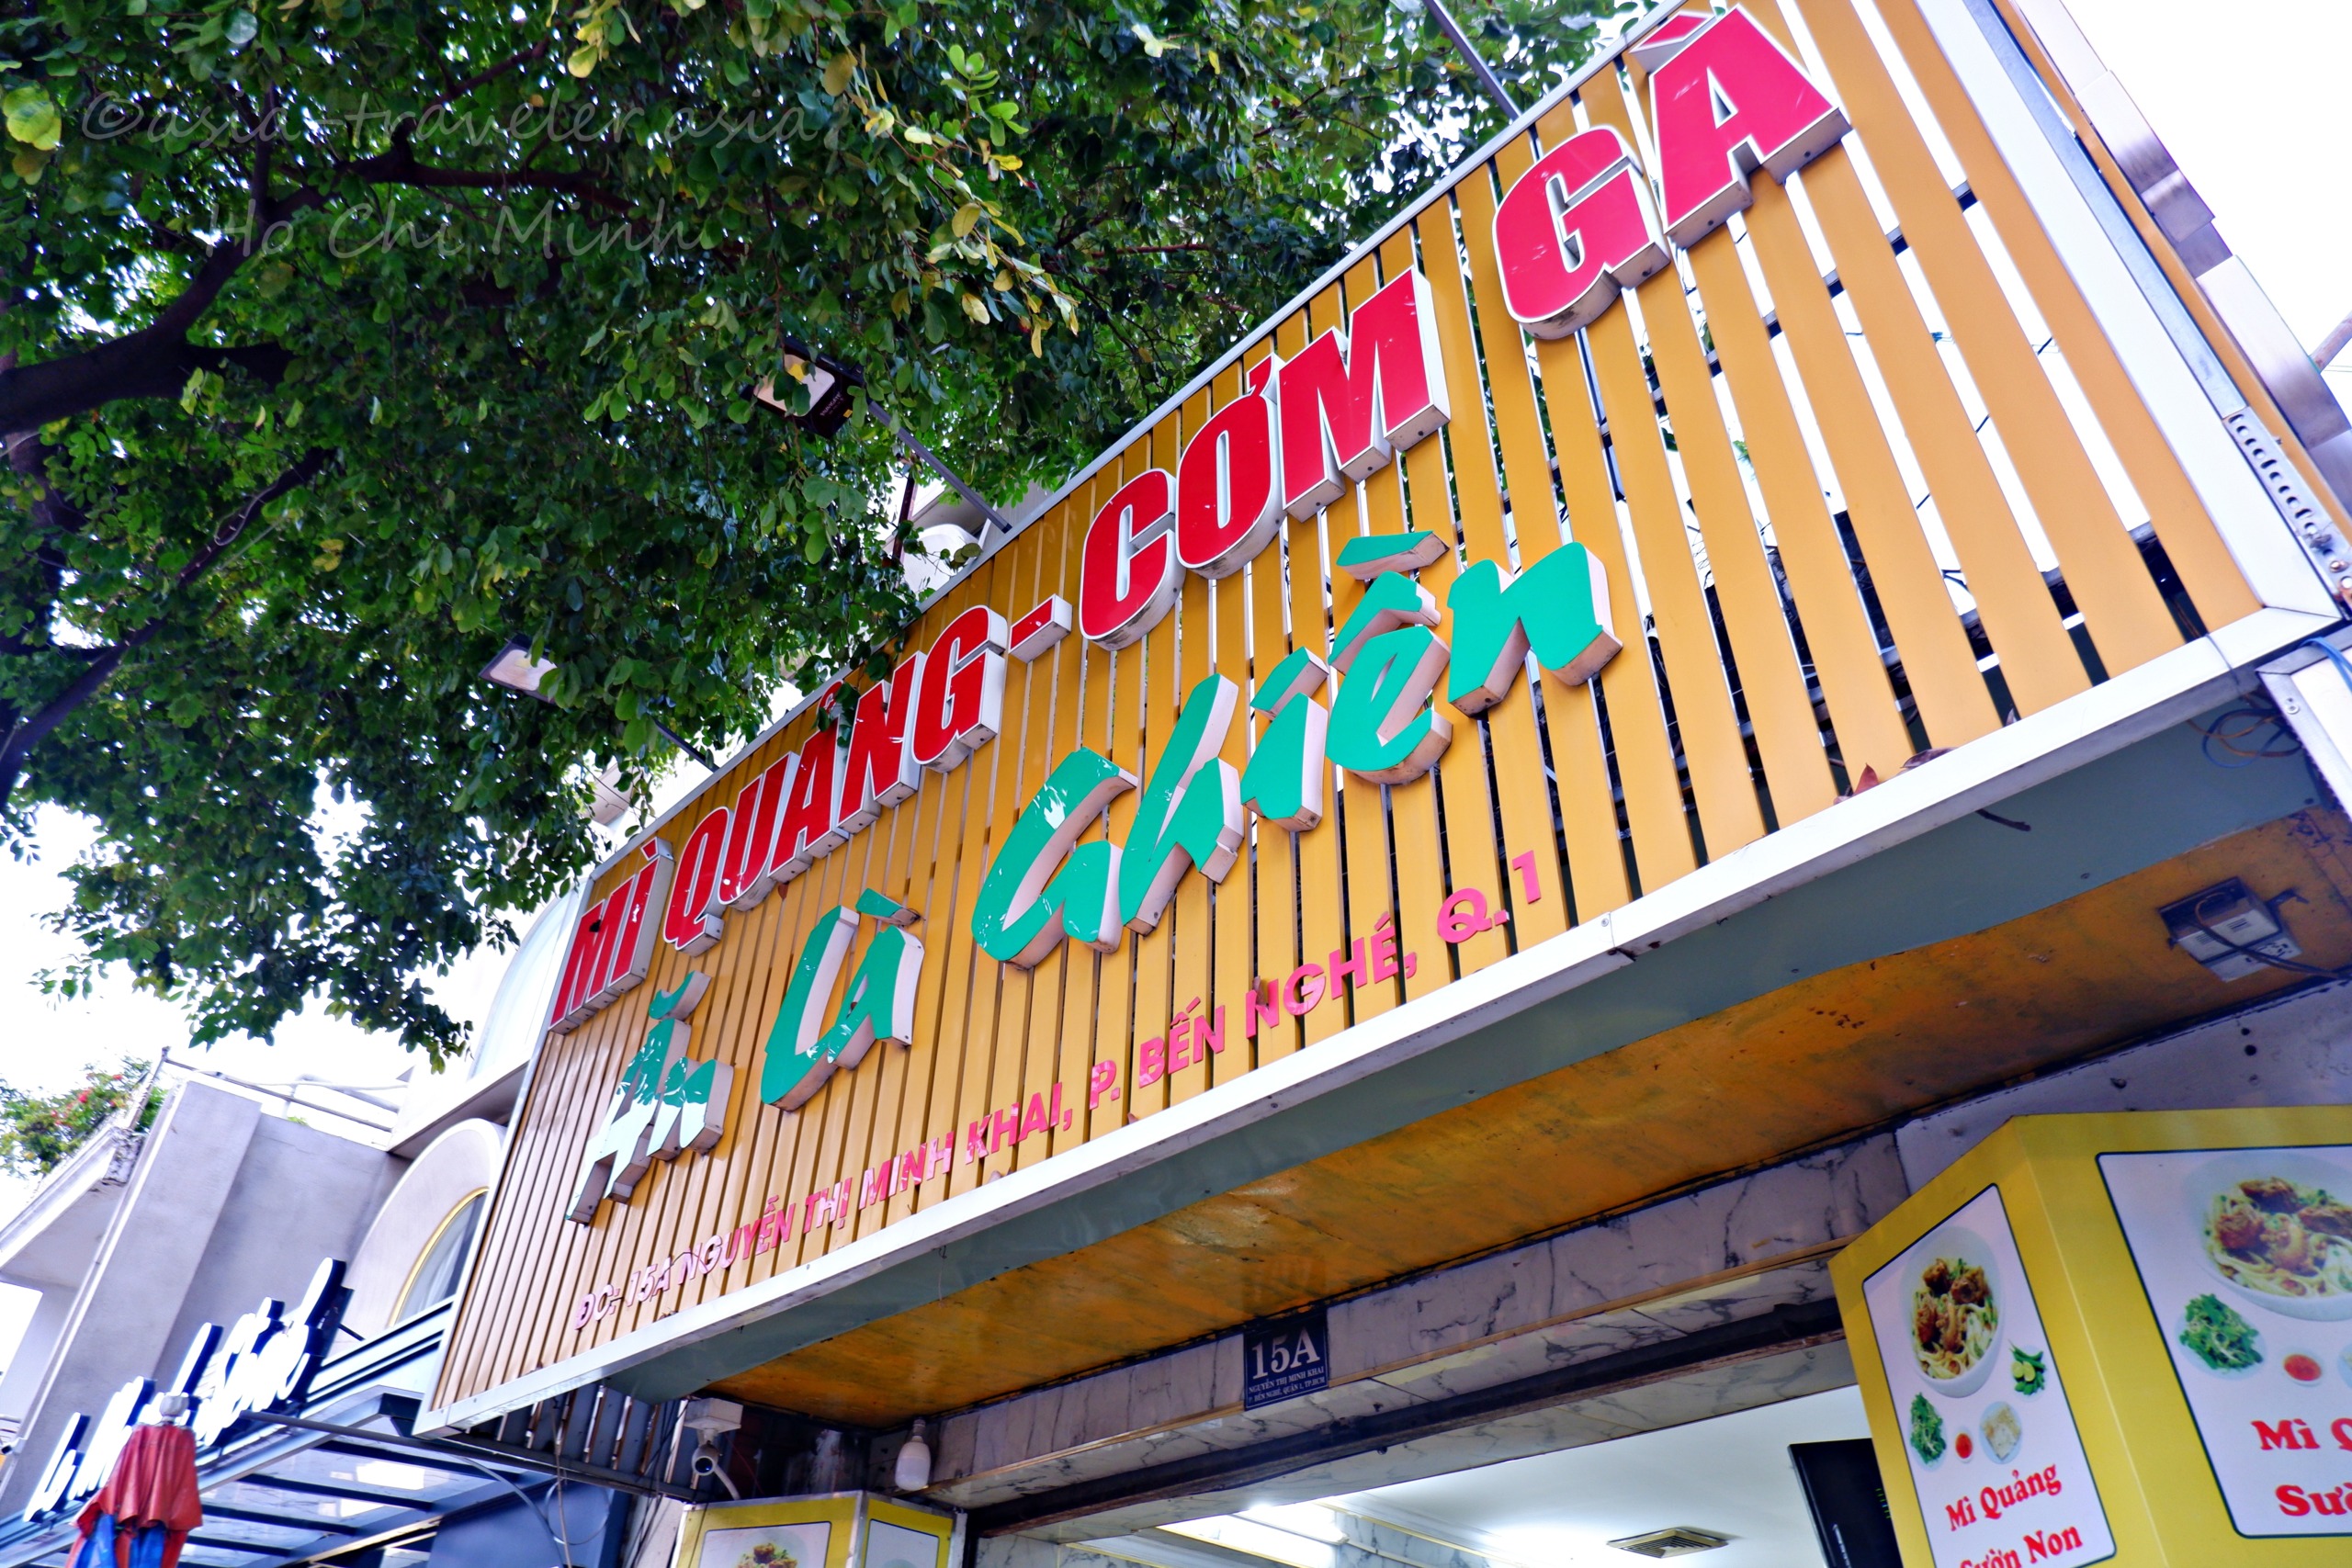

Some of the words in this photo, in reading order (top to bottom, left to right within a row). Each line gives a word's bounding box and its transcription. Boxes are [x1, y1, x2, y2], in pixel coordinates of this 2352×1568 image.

[548, 836, 673, 1033] MÌ
[663, 604, 1009, 956] QUẢNG
[1080, 265, 1450, 650] CƠM
[1493, 3, 1851, 339] GÀ
[566, 971, 734, 1225] Ăn
[761, 887, 925, 1112] Là
[971, 530, 1623, 970] Ghiền
[625, 1256, 673, 1307] 15A
[678, 1195, 796, 1285] NGUYỄN
[802, 1177, 853, 1233] THỊ
[859, 1131, 955, 1210] MINH
[965, 1081, 1073, 1165] KHAI,
[1089, 1059, 1121, 1111] P.
[1138, 997, 1226, 1089] BẾN
[1246, 911, 1418, 1040] NGHÉ,
[1437, 887, 1510, 944] Q.
[1512, 850, 1542, 905] 1
[1251, 1327, 1320, 1379] 15A
[1288, 1371, 1306, 1382] MINH
[1306, 1366, 1325, 1378] KHAI
[2250, 1418, 2321, 1450] Mì
[1945, 1496, 1977, 1531] Mì
[1980, 1463, 2063, 1520] Quảng
[2275, 1482, 2352, 1517] Sư
[2023, 1526, 2084, 1564] Non
